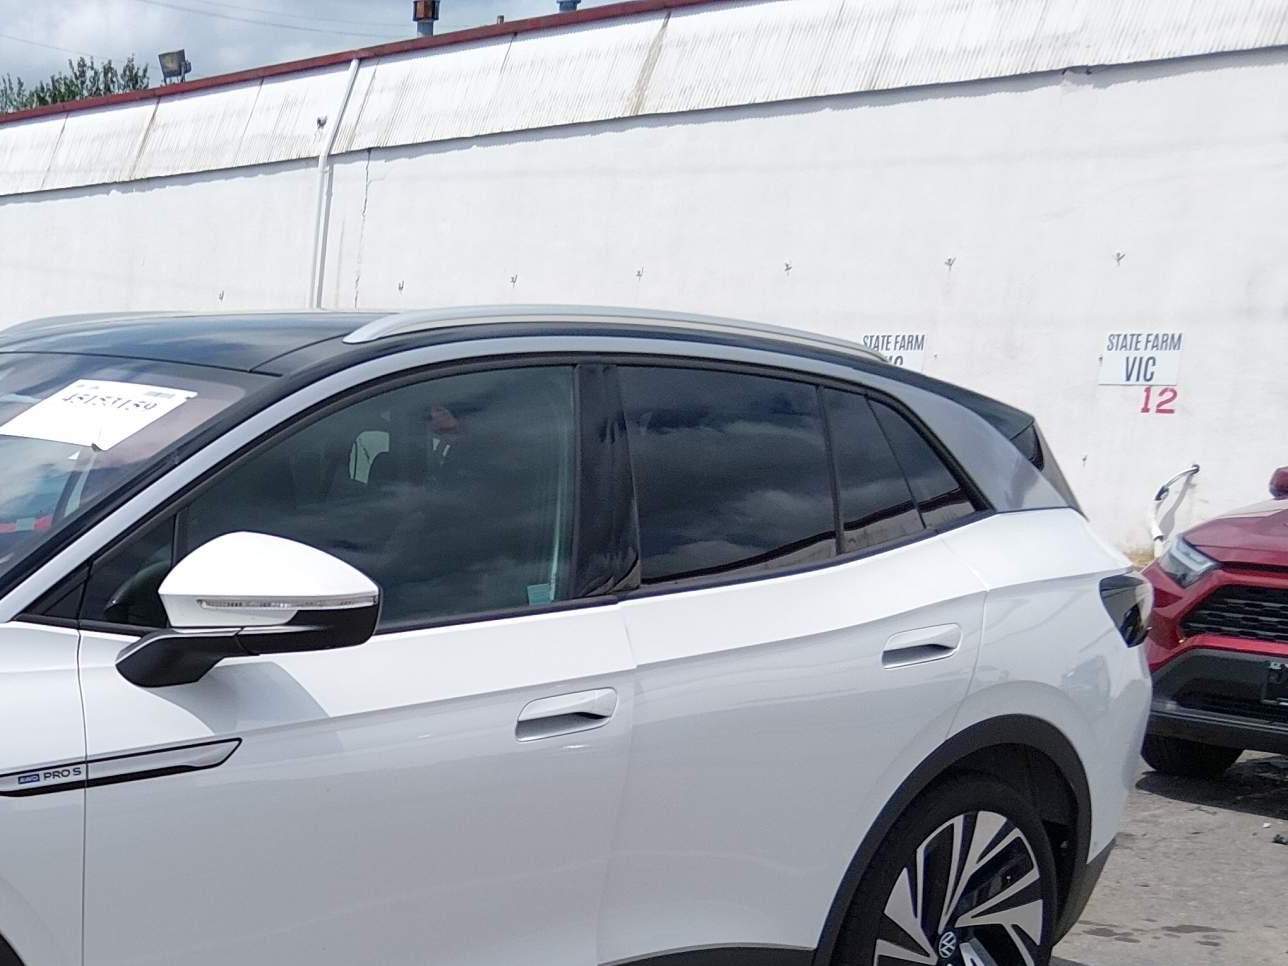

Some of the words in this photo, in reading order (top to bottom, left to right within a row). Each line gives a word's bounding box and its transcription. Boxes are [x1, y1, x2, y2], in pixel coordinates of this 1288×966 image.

[862, 334, 892, 352] STATE
[893, 334, 926, 351] FARM
[1106, 333, 1142, 351] STATE
[1143, 333, 1183, 351] FARM
[1125, 356, 1156, 382] VIC
[1141, 386, 1178, 414] 12
[43, 769, 71, 781] PRO
[72, 767, 82, 776] S
